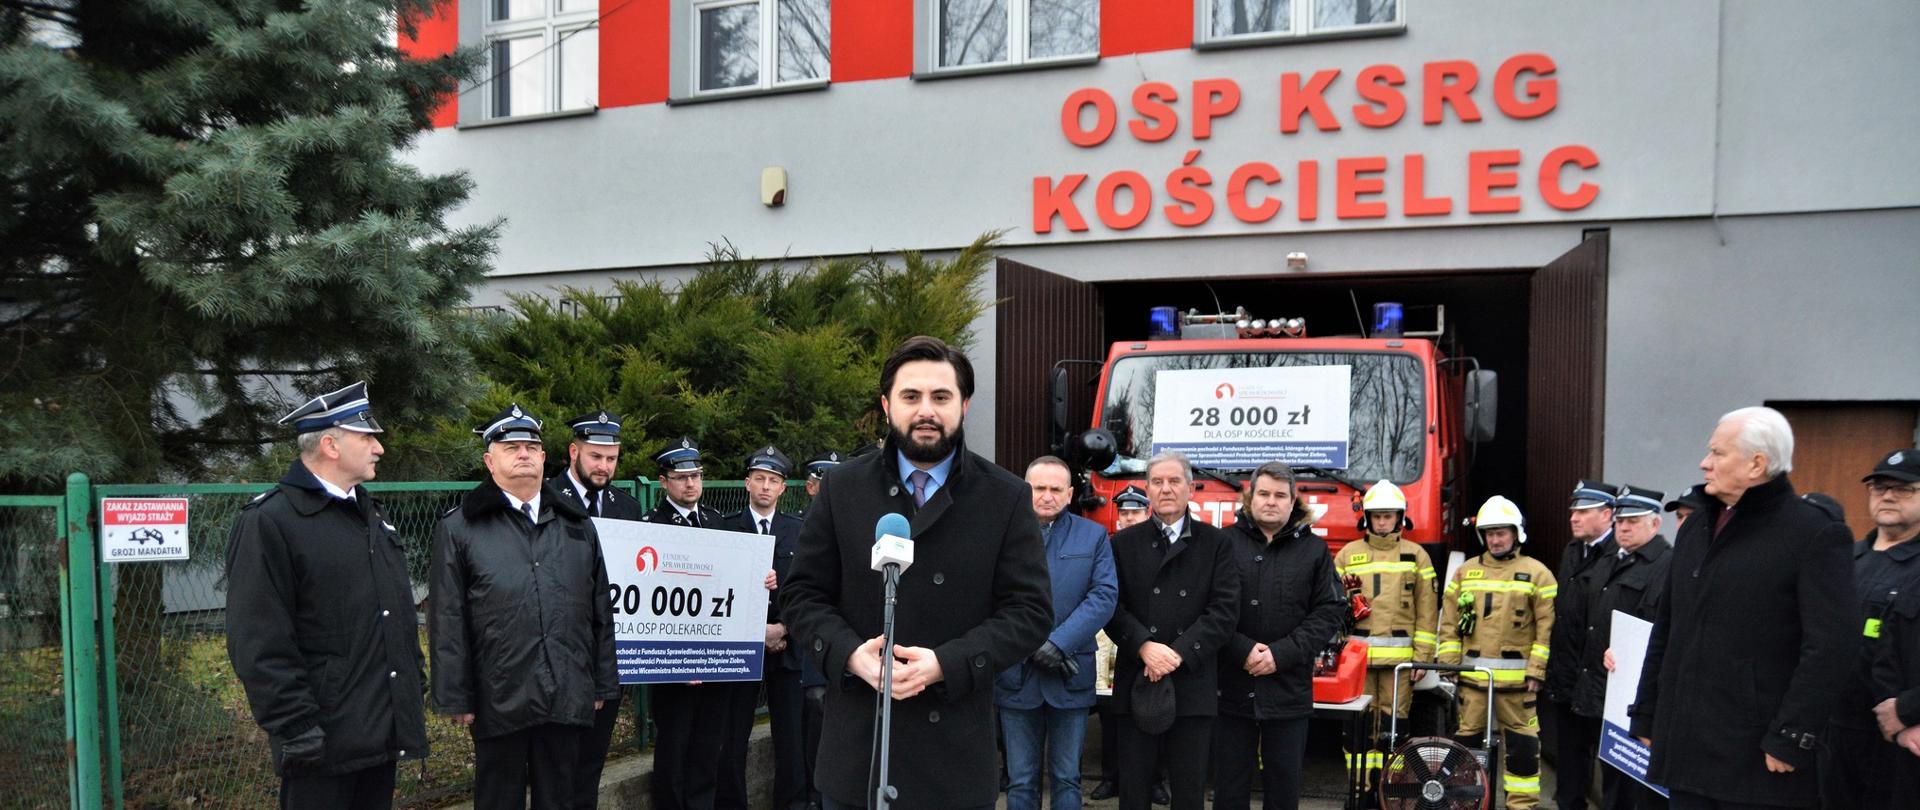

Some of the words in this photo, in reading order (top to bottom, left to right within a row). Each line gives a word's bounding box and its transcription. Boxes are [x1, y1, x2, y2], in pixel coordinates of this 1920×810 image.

[1061, 78, 1241, 148] OSP
[1280, 53, 1558, 134] KSRG
[1033, 145, 1601, 234] KOŚCIELEC
[1190, 407, 1220, 426] 28
[1230, 406, 1278, 426] 000
[1287, 404, 1311, 425] zł
[1204, 429, 1222, 439] DLA
[1224, 429, 1243, 439] OSP
[1244, 427, 1294, 438] KOŚCIELEC
[106, 502, 132, 511] ZAKAZ
[133, 502, 185, 511] ZASTAWIANIA
[117, 512, 146, 523] WYJAZD
[147, 511, 174, 521] STRAŻY
[111, 548, 136, 557] GROZI
[138, 547, 182, 556] MANDATEM
[608, 583, 640, 615] 20
[651, 585, 703, 617] 000
[710, 588, 735, 618] zł
[614, 622, 634, 634] DLA
[637, 622, 658, 635] OSP
[660, 623, 722, 635] POLEKARCICE
